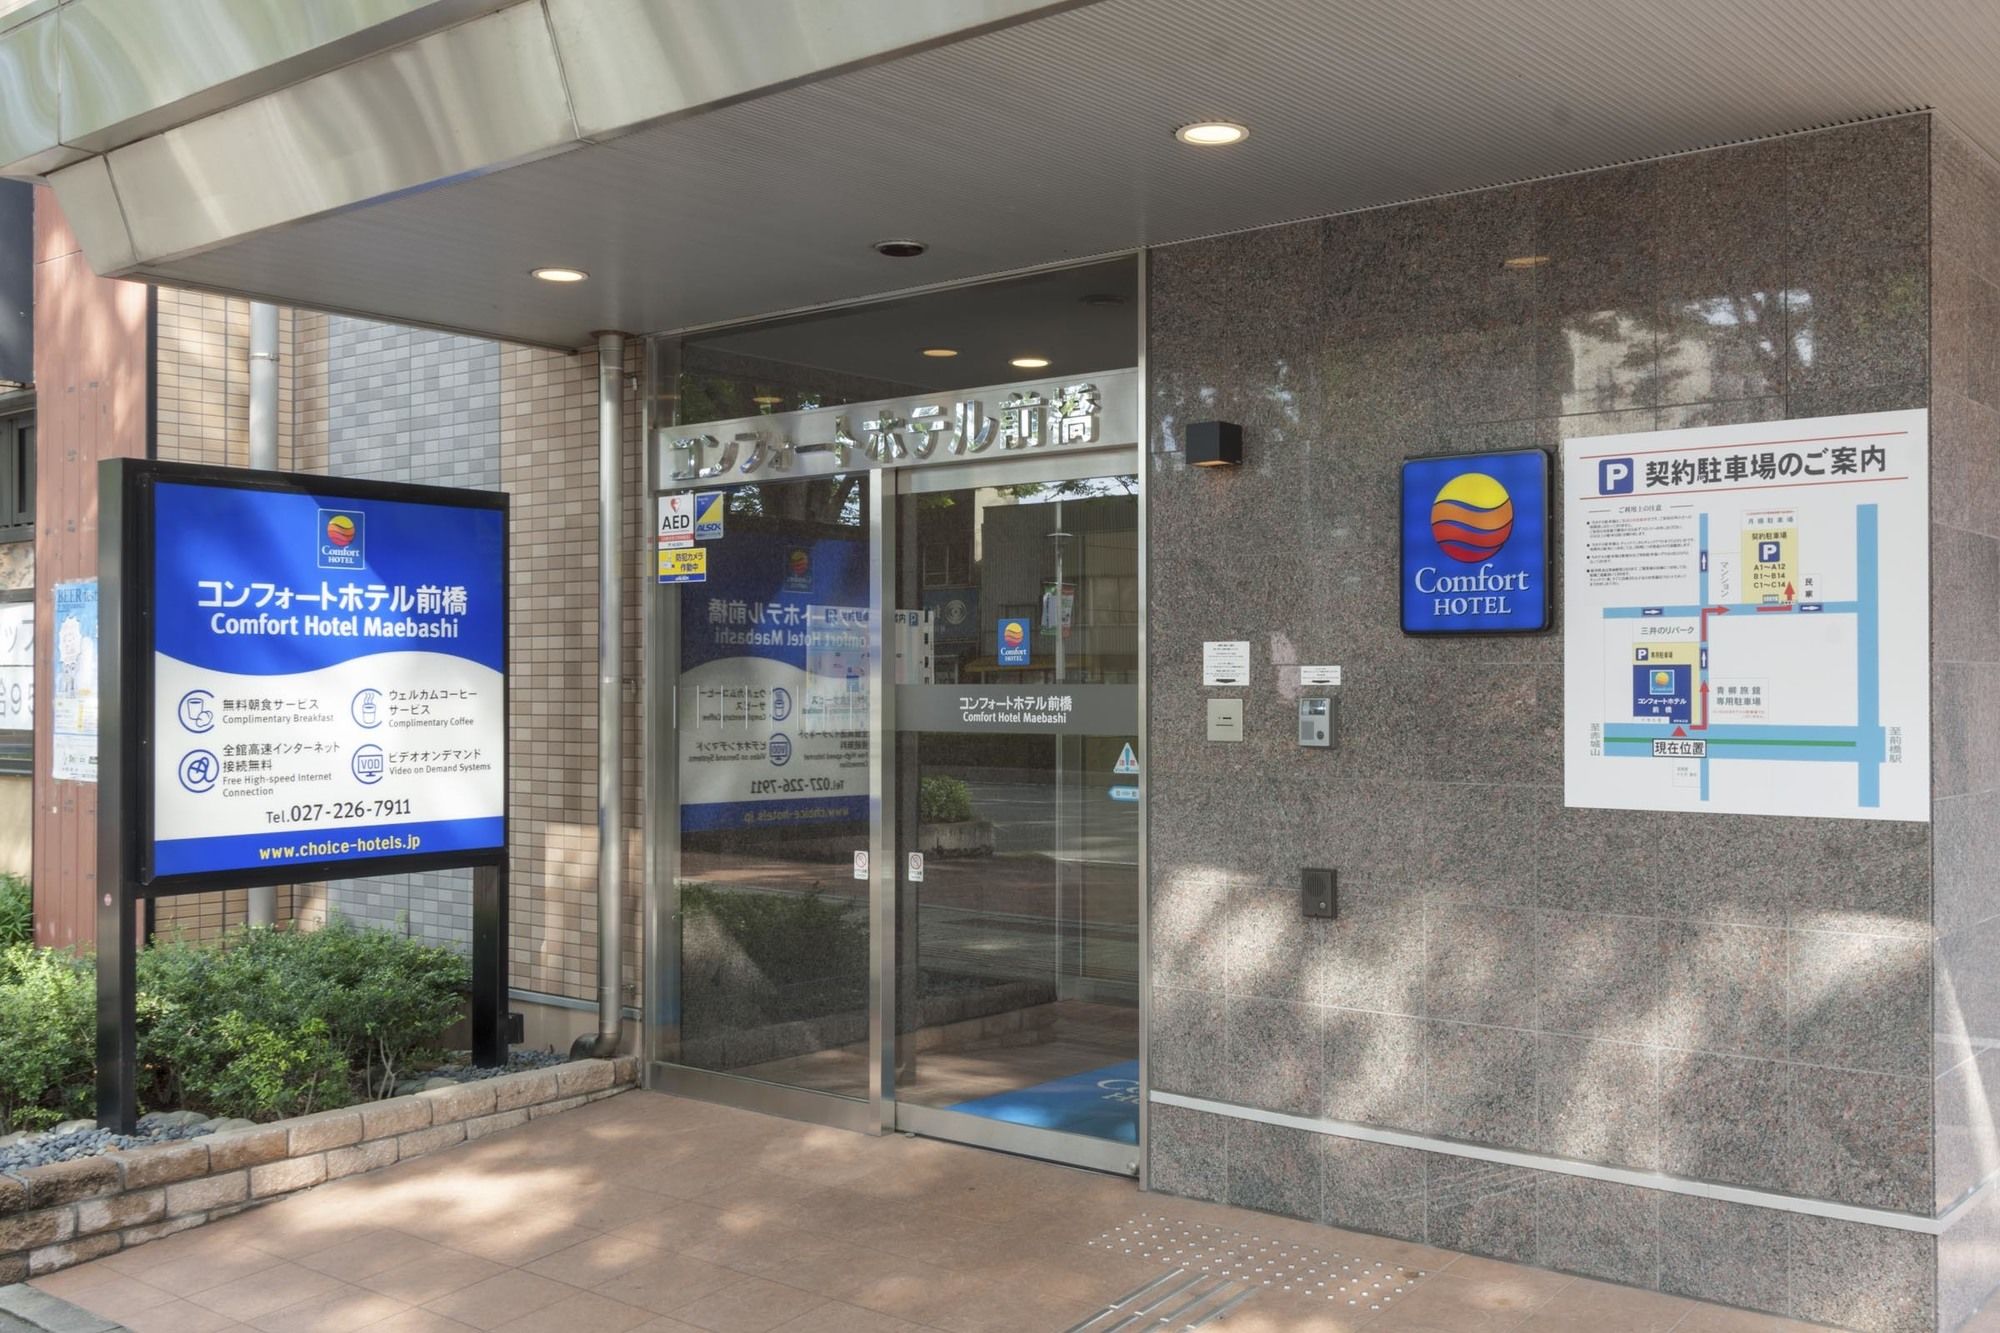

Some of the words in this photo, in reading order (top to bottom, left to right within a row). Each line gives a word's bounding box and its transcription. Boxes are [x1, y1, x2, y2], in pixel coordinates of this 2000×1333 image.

[670, 381, 1102, 481] コンフォートホテル前橋
[1606, 463, 1629, 491] P
[1646, 444, 1886, 488] 契約駐車場のご案内
[661, 514, 690, 531] AED
[322, 545, 360, 557] Comfort
[1762, 544, 1777, 560] P
[328, 556, 354, 564] HOTEL
[1415, 563, 1529, 593] Comfort
[198, 580, 468, 615] コンフォートホテル前橋
[1433, 596, 1511, 616] HOTEL
[211, 612, 299, 635] Comfort
[304, 615, 358, 637] Hotel
[363, 616, 459, 638] Maebashi
[1000, 646, 1027, 656] Comfort
[1637, 649, 1647, 660] P
[388, 689, 478, 701] ウェルカムコーヒー
[222, 698, 320, 712] 無料朝食サービス
[389, 704, 431, 716] サービス
[959, 695, 1073, 712] コンフォートホテル前橋
[222, 714, 291, 725] Complimentary
[293, 714, 334, 723] Breakfast
[388, 718, 449, 729] Complimentary
[449, 717, 474, 727] Coffee
[963, 711, 996, 722] Comfort
[998, 712, 1021, 723] Hotel
[1023, 712, 1067, 724] Maebashi
[223, 741, 341, 757] 全館高速インターネット
[1654, 741, 1705, 755] 現在位置
[388, 748, 481, 764] ビデオオンデマンド
[223, 759, 273, 773] 接続無料
[361, 758, 381, 770] VOD
[389, 766, 412, 775] Video
[426, 764, 458, 774] Demand
[459, 762, 492, 773] Systems
[222, 775, 243, 785] Free
[244, 773, 296, 785] High-speed
[298, 772, 332, 782] Internet
[222, 786, 274, 798] Connection
[259, 834, 421, 861] www.choice-hotels.jp
